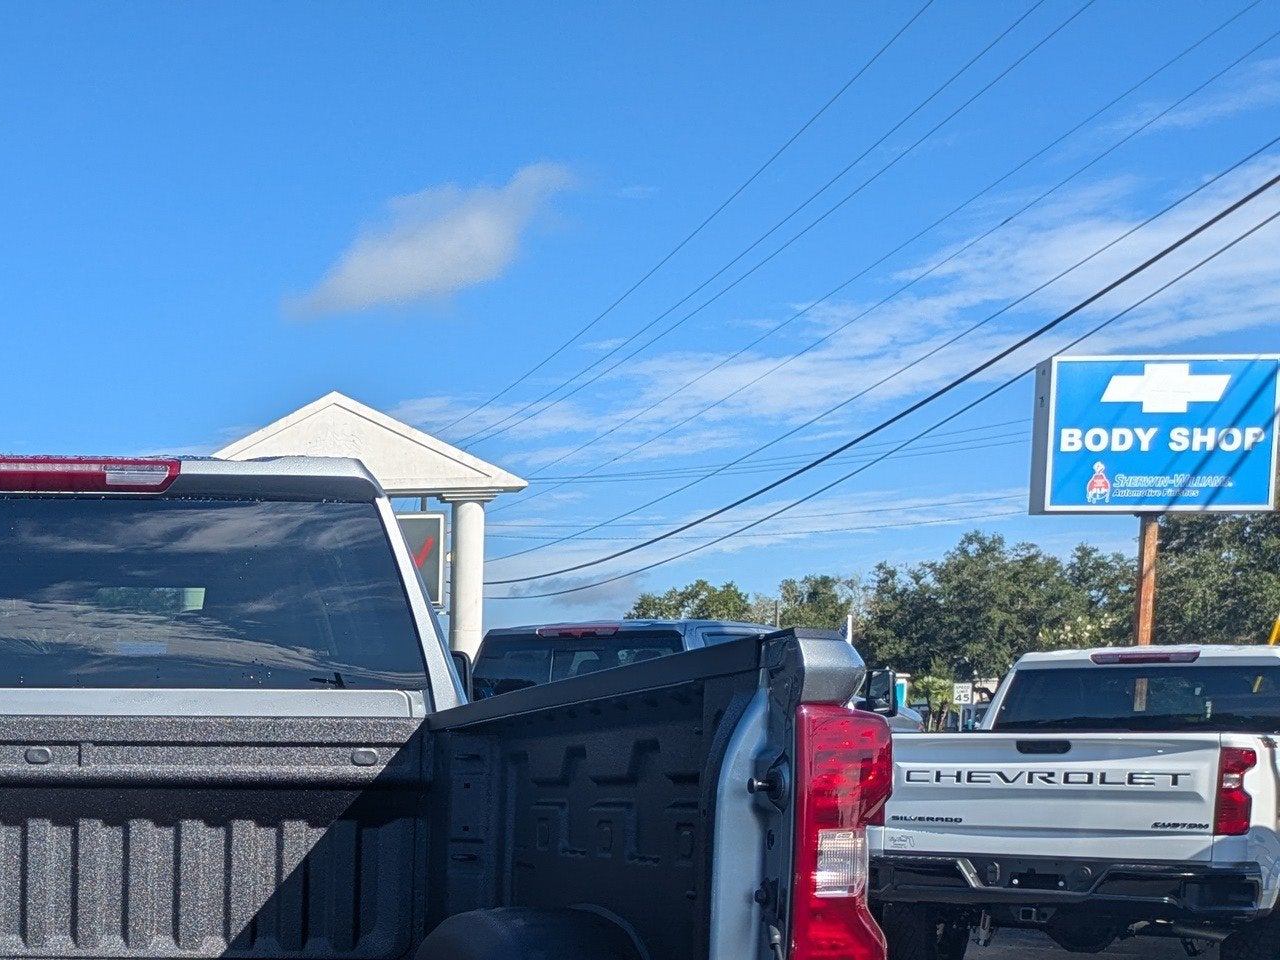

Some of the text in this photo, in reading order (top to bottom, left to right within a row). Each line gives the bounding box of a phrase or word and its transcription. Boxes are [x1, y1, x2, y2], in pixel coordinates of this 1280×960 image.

[1059, 426, 1266, 452] BODY SHOP
[955, 694, 970, 702] 45
[905, 769, 1191, 787] CHEVROLET
[891, 815, 963, 823] SILVERADO
[1150, 821, 1210, 830] CUSTOM
